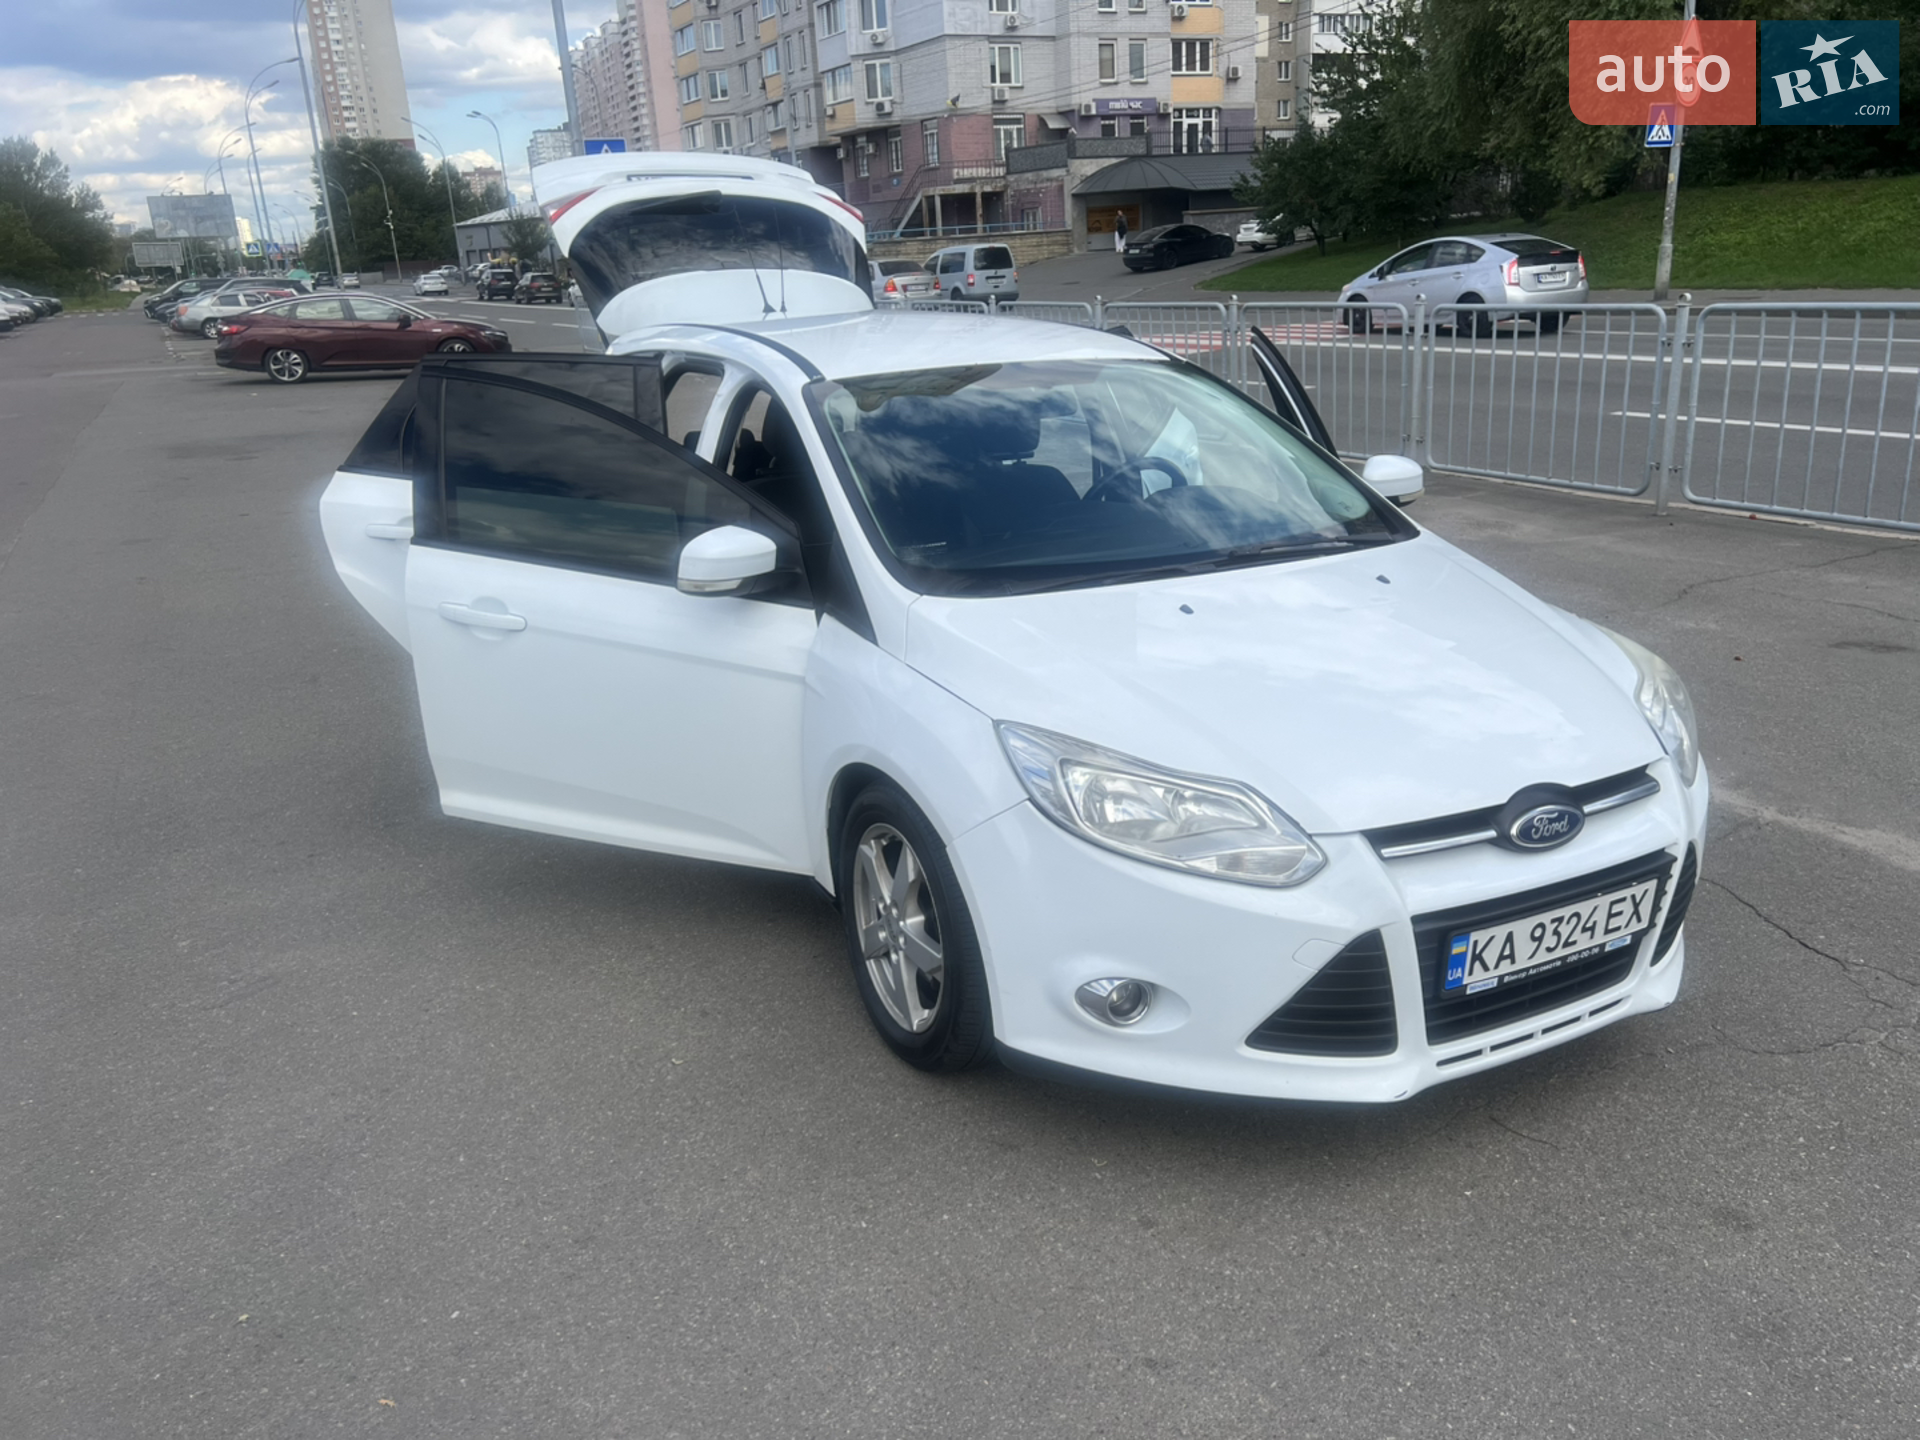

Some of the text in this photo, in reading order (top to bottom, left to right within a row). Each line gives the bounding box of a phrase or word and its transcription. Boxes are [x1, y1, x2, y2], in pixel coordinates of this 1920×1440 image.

[1531, 811, 1570, 840] Ford
[1468, 887, 1650, 977] KA 9324 EX
[1447, 967, 1462, 981] UA
